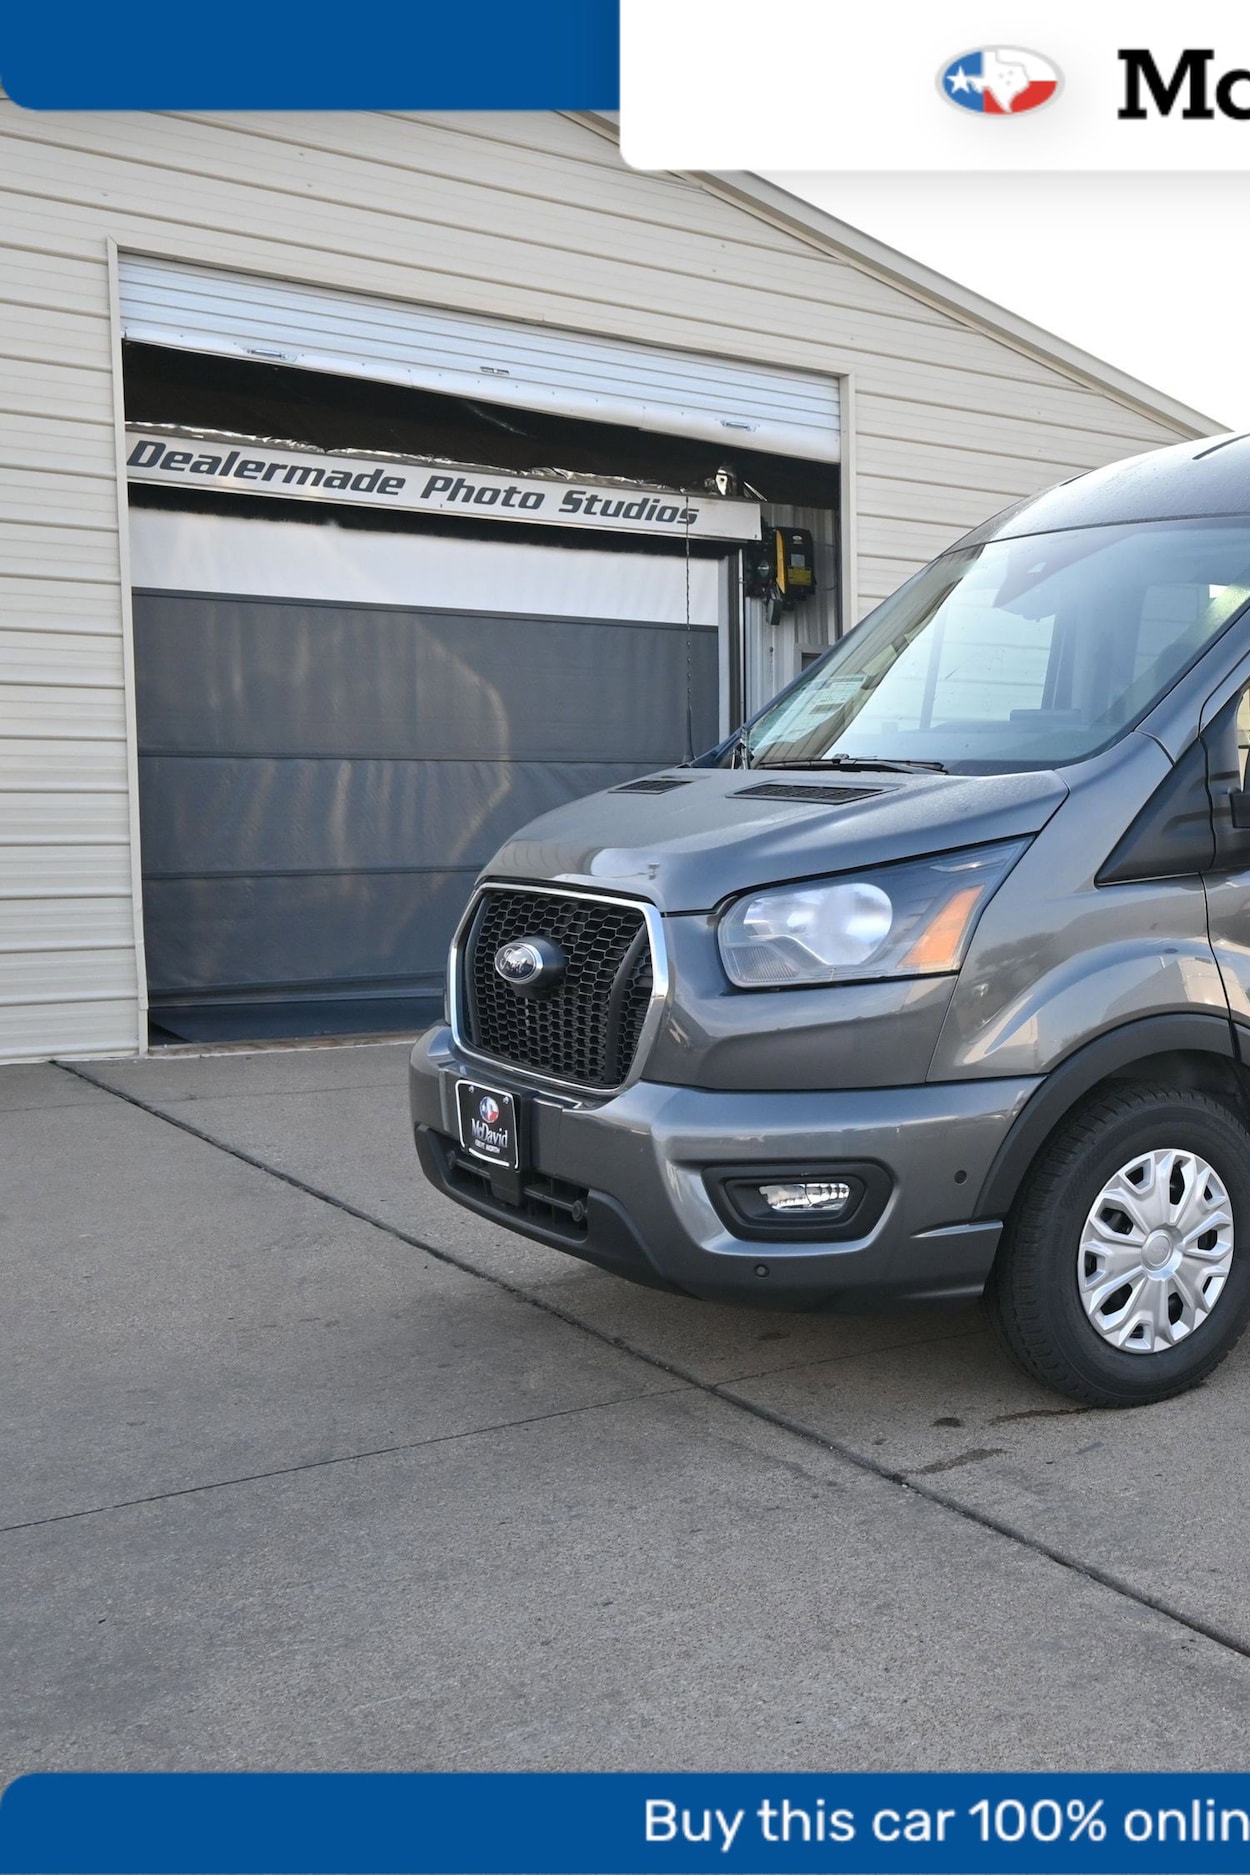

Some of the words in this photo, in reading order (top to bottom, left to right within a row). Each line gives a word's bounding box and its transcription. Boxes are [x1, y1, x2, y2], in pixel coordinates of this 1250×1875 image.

[126, 439, 406, 495] Dealermade
[420, 475, 545, 510] Photo
[558, 490, 699, 525] Studios
[471, 1117, 508, 1149] McDavid
